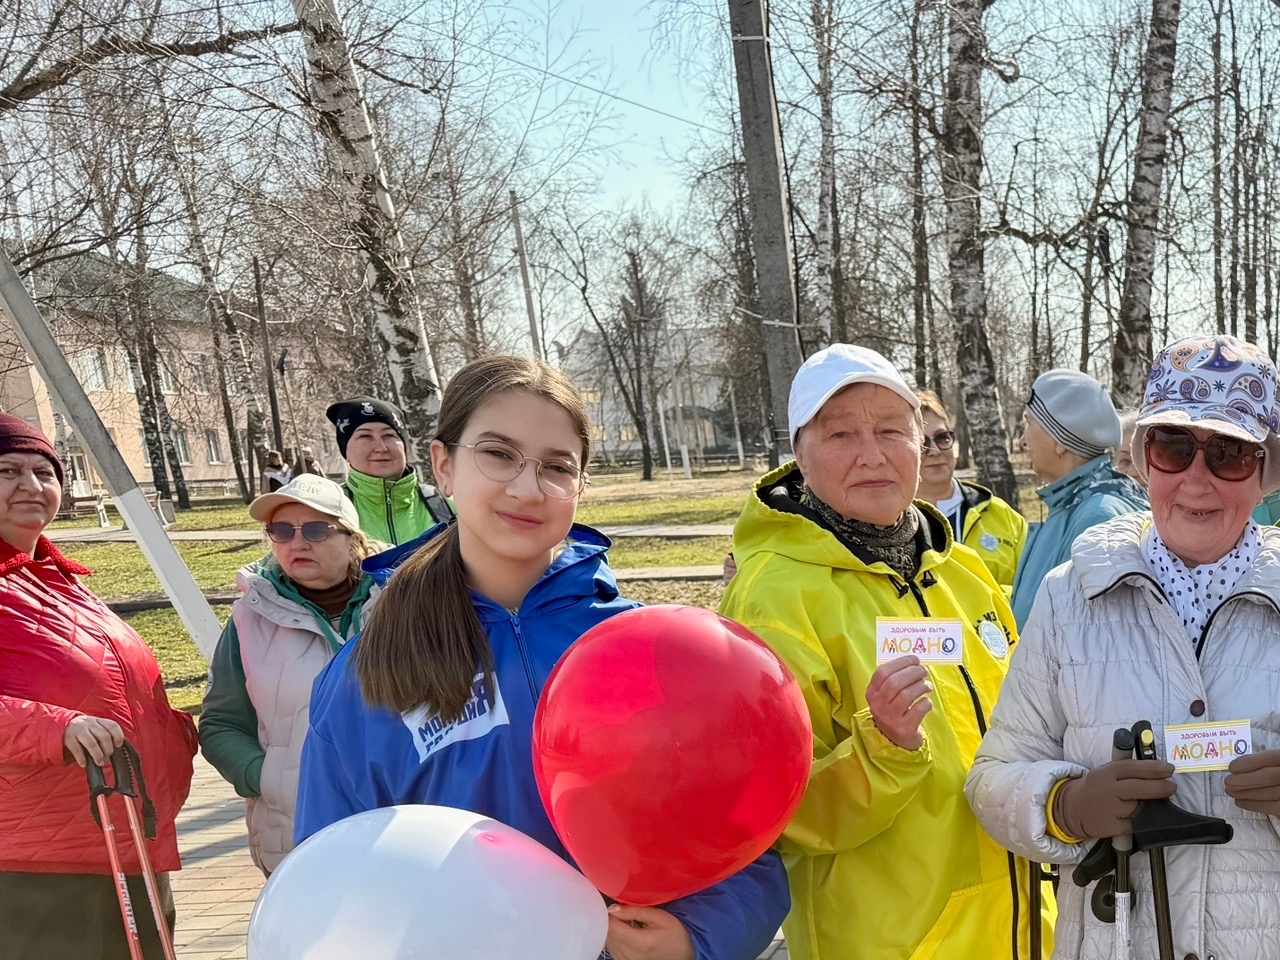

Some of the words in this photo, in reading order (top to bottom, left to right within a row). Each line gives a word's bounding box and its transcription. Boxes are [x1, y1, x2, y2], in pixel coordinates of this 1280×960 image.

[890, 626, 927, 634] ЗДОРОВЫМ
[881, 637, 956, 655] МОДНО
[1180, 732, 1218, 740] ЗДОРОВЫМ
[1171, 739, 1248, 761] МОДНО
